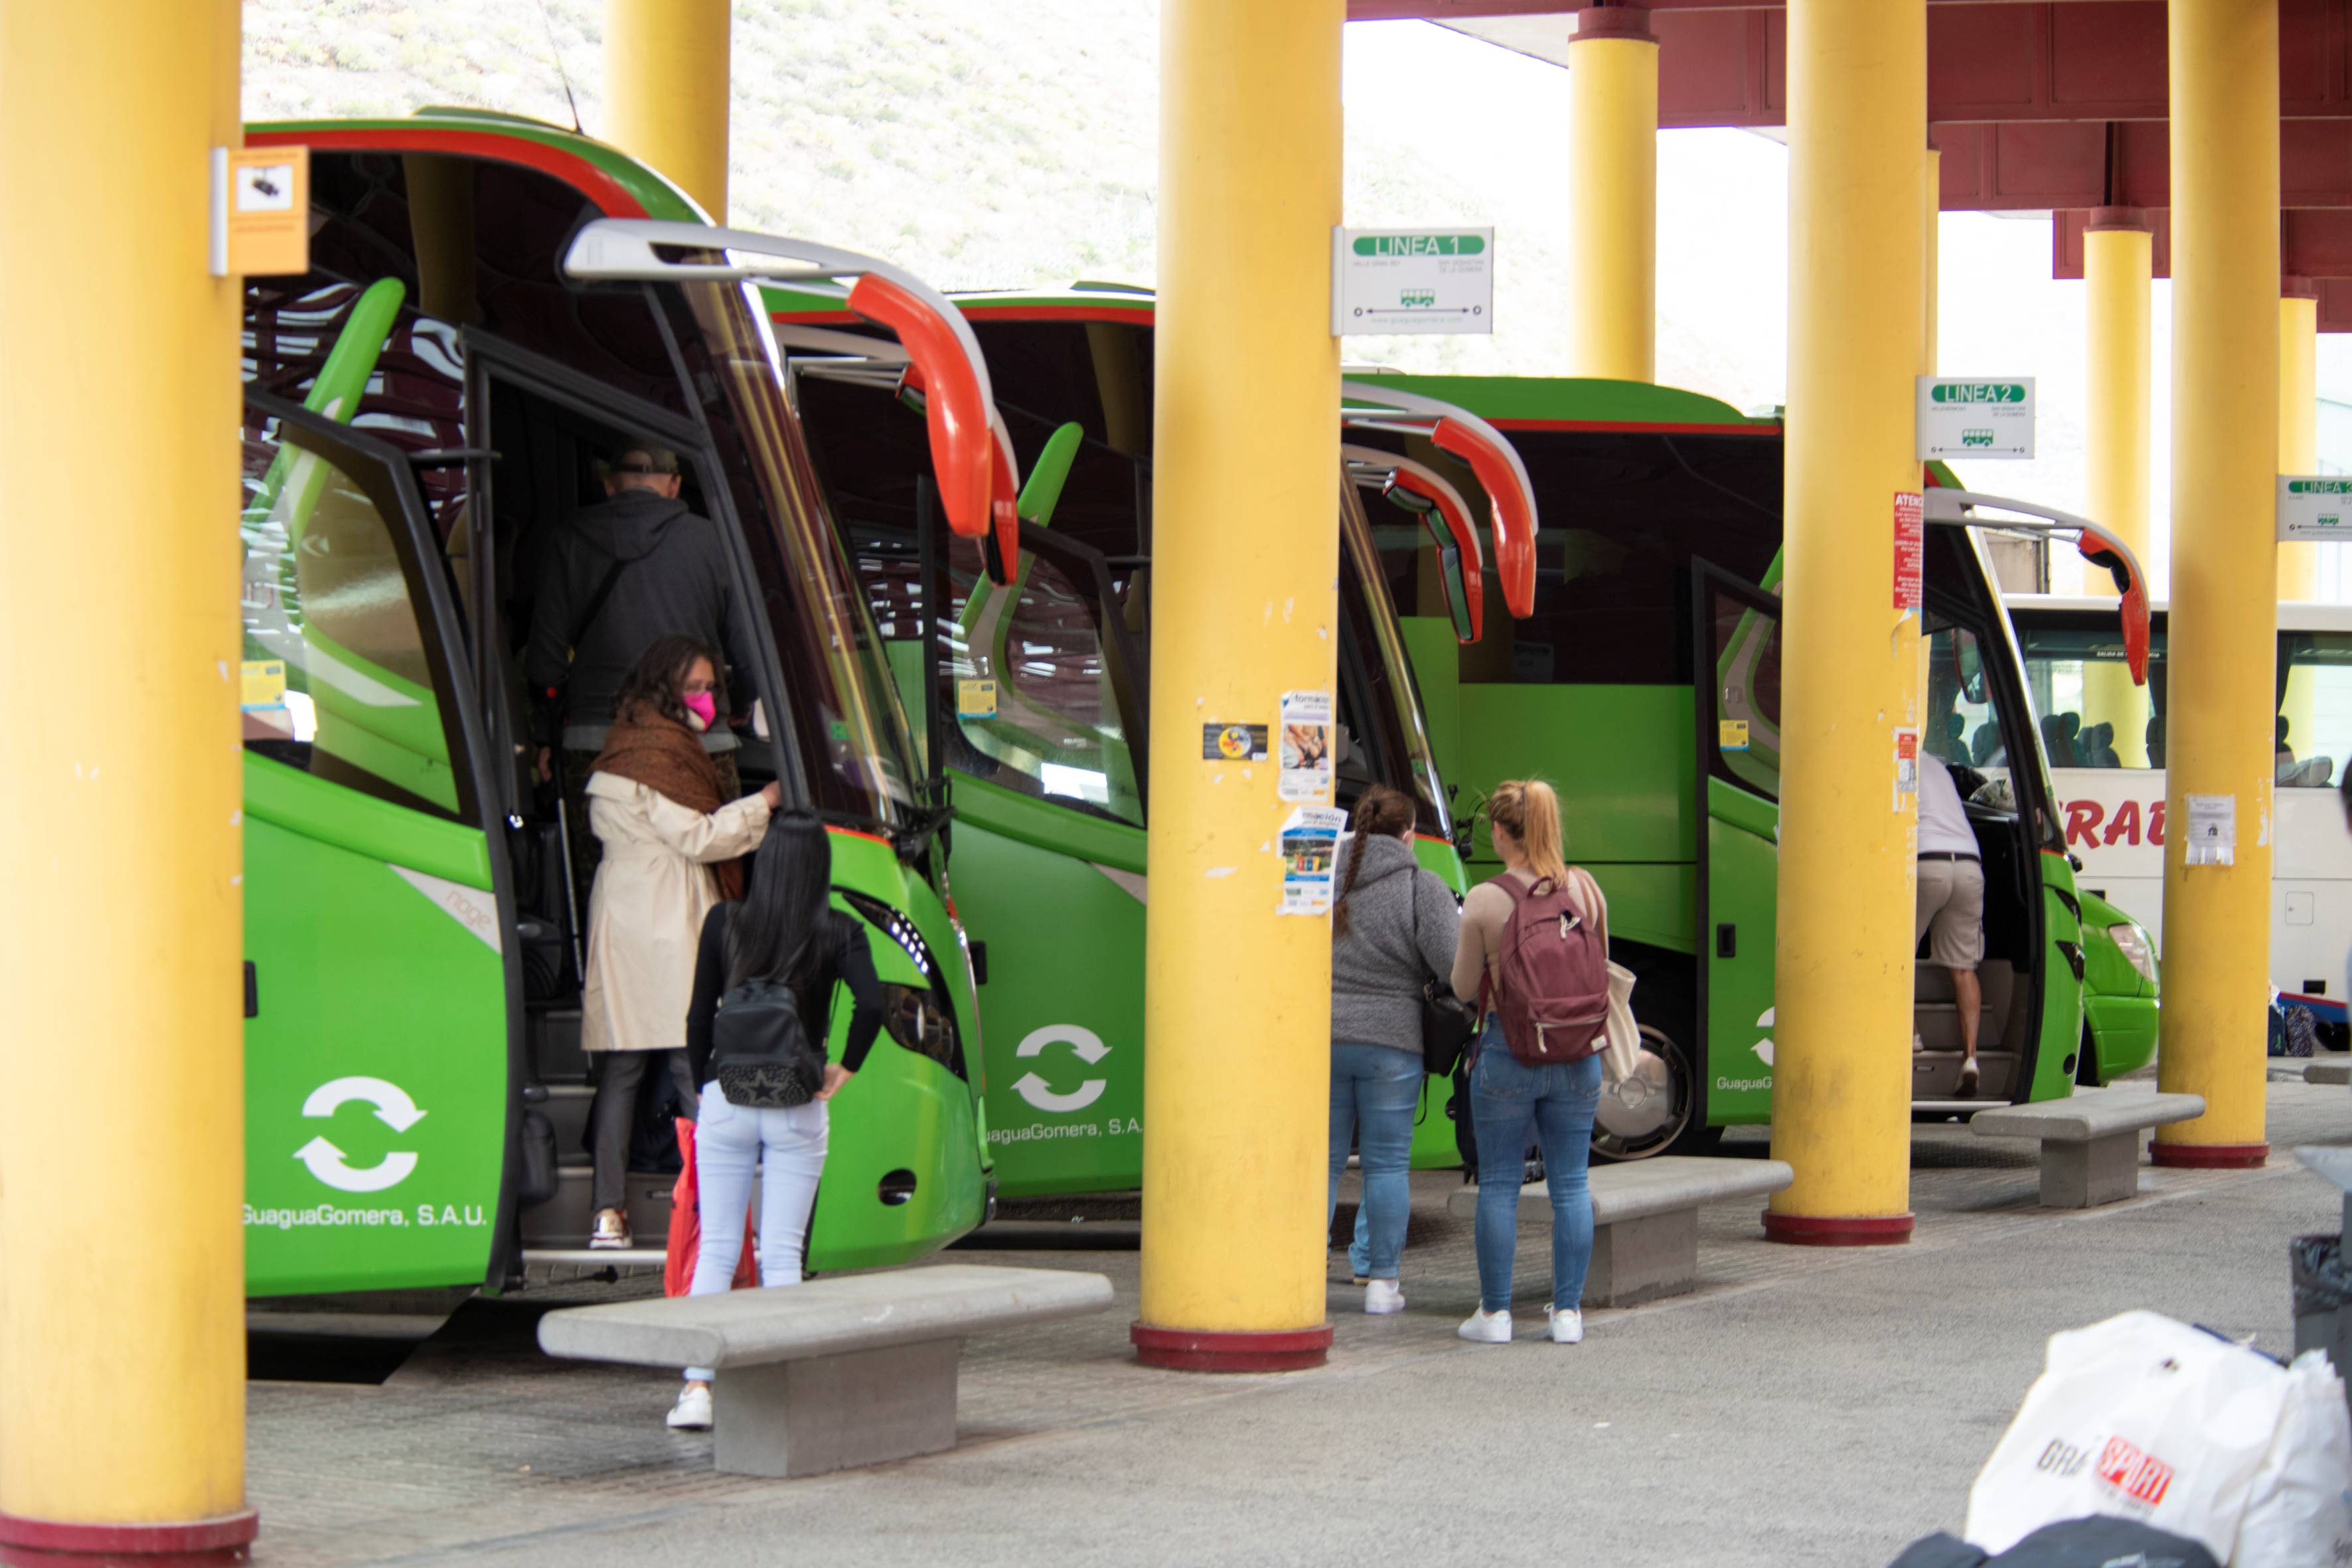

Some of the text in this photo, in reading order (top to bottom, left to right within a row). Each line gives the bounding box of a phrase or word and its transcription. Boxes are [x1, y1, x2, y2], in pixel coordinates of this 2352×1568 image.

[1375, 236, 1459, 256] LINEA 1
[1945, 384, 2012, 403] LINEA 2
[2302, 481, 2342, 493] LINEA
[446, 892, 491, 931] noge
[417, 1204, 487, 1226] S.A.U.
[2100, 1438, 2172, 1504] SPORT
